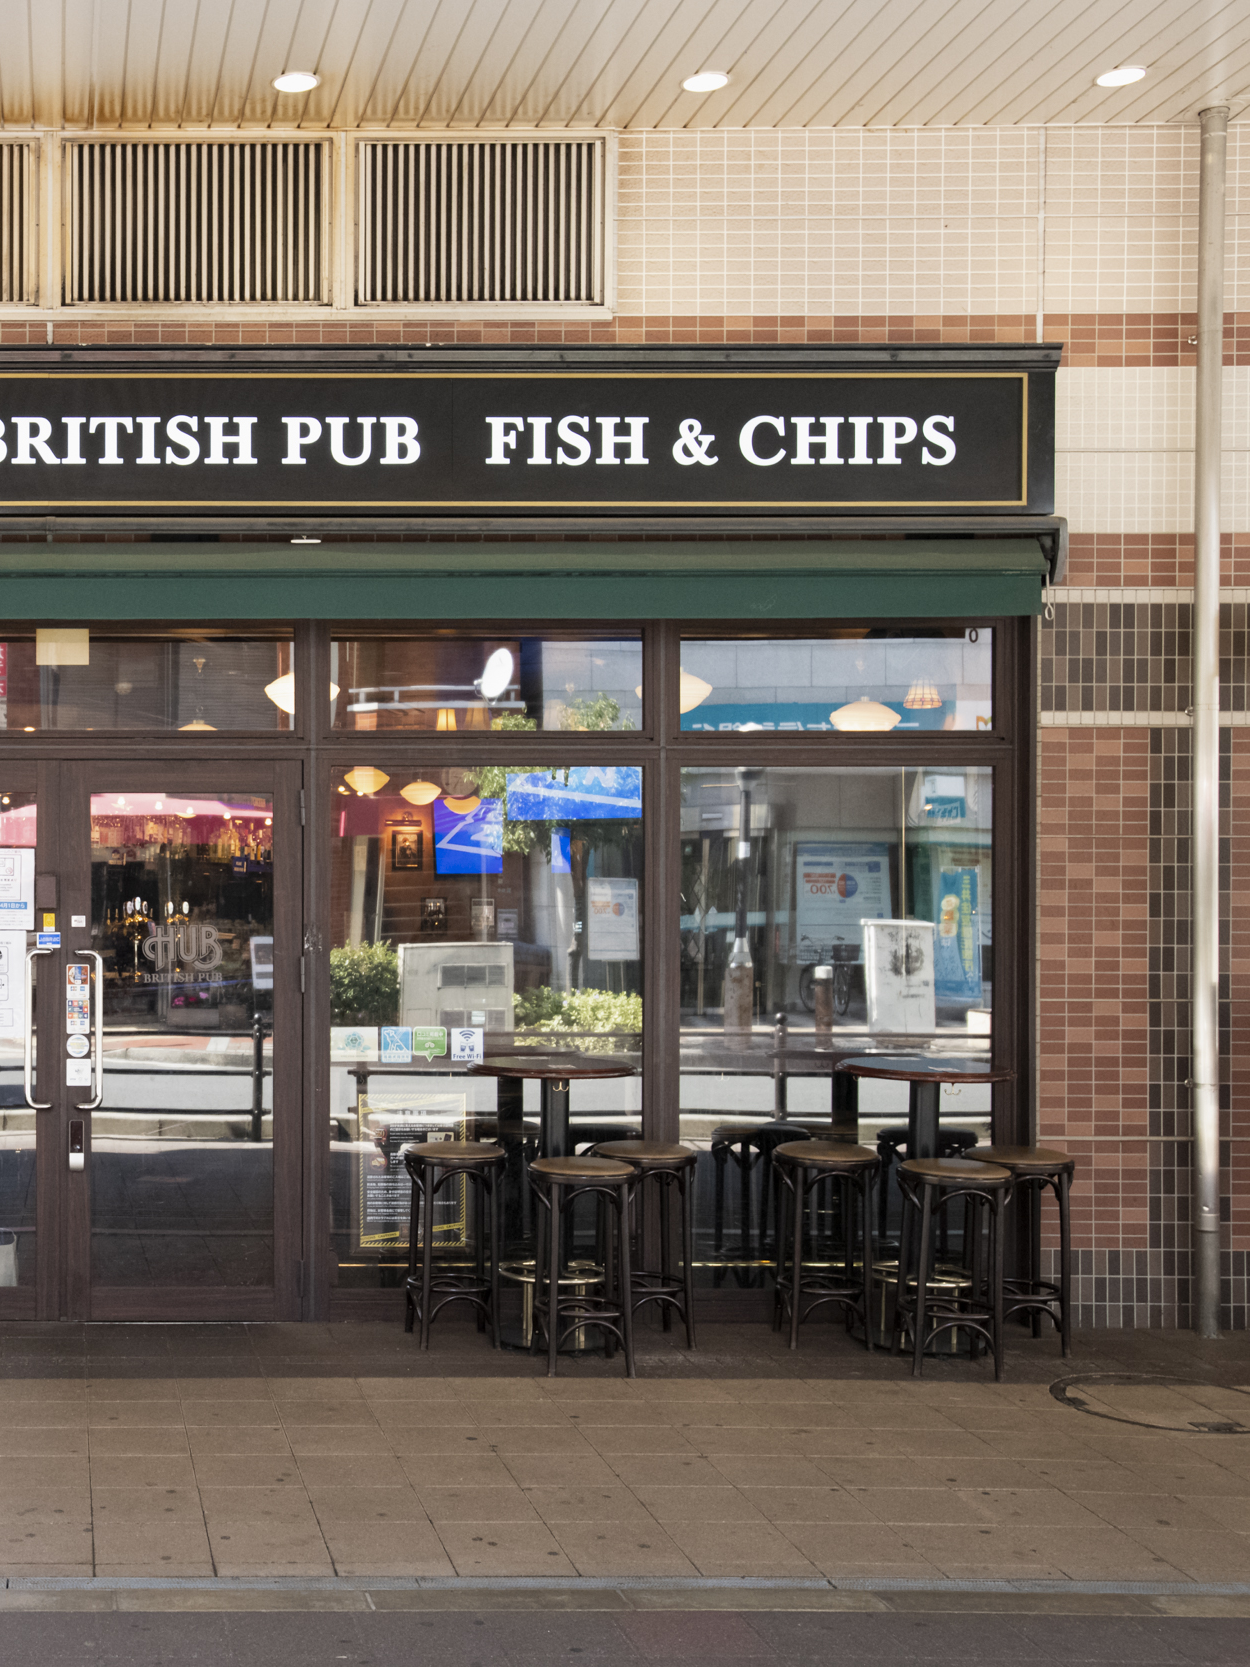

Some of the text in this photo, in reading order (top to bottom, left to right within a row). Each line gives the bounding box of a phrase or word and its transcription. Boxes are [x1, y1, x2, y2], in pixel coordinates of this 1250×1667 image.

[281, 416, 421, 466] PUB
[485, 414, 957, 466] FISH & CHIPS
[142, 925, 223, 971] HUB
[143, 972, 223, 984] BRITISH PUB
